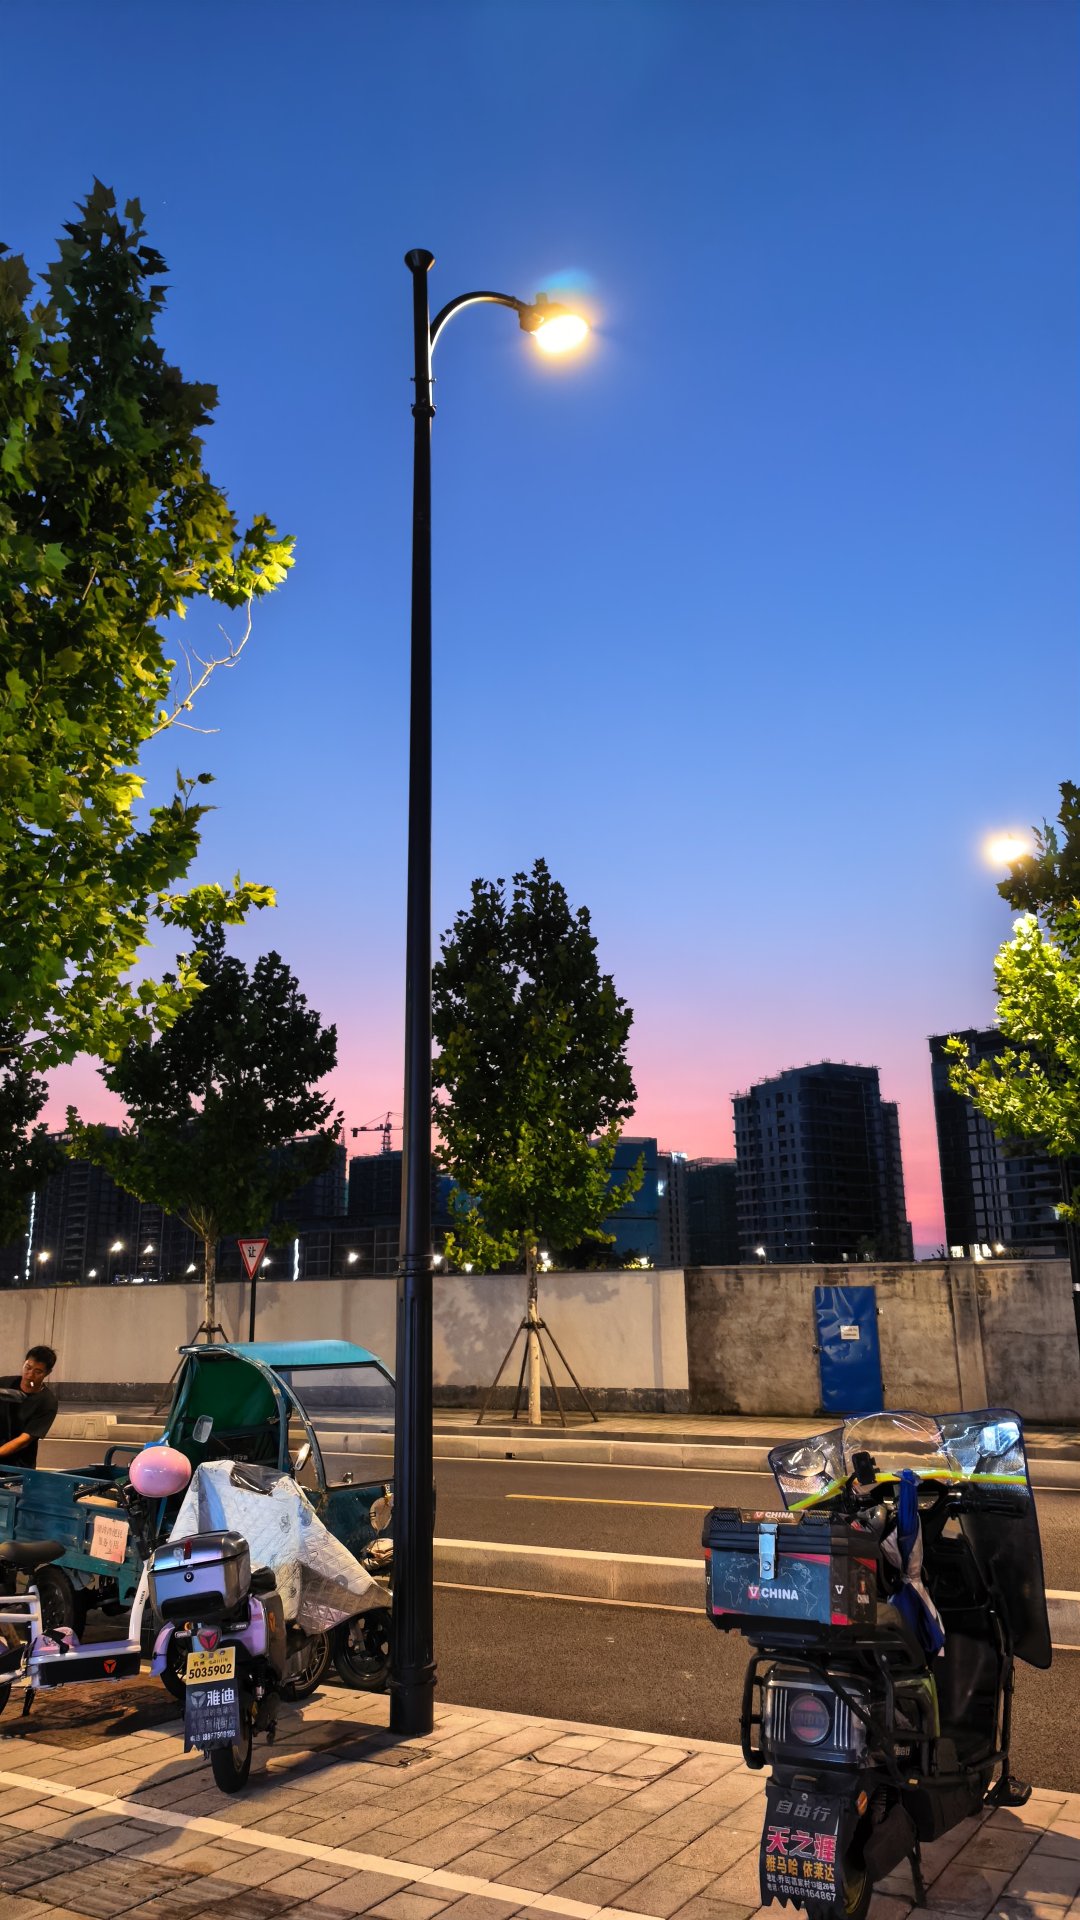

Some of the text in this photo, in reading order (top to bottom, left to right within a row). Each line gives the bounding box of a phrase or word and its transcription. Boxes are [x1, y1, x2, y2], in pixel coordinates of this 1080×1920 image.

[248, 1246, 256, 1258] 让
[761, 1588, 799, 1600] CHINA
[188, 1663, 232, 1679] 5035902
[206, 1688, 235, 1706] 雅迪
[775, 1800, 832, 1822] 自由行
[765, 1825, 838, 1864] 天之涯
[765, 1854, 835, 1882] 雅马哈 依莱达
